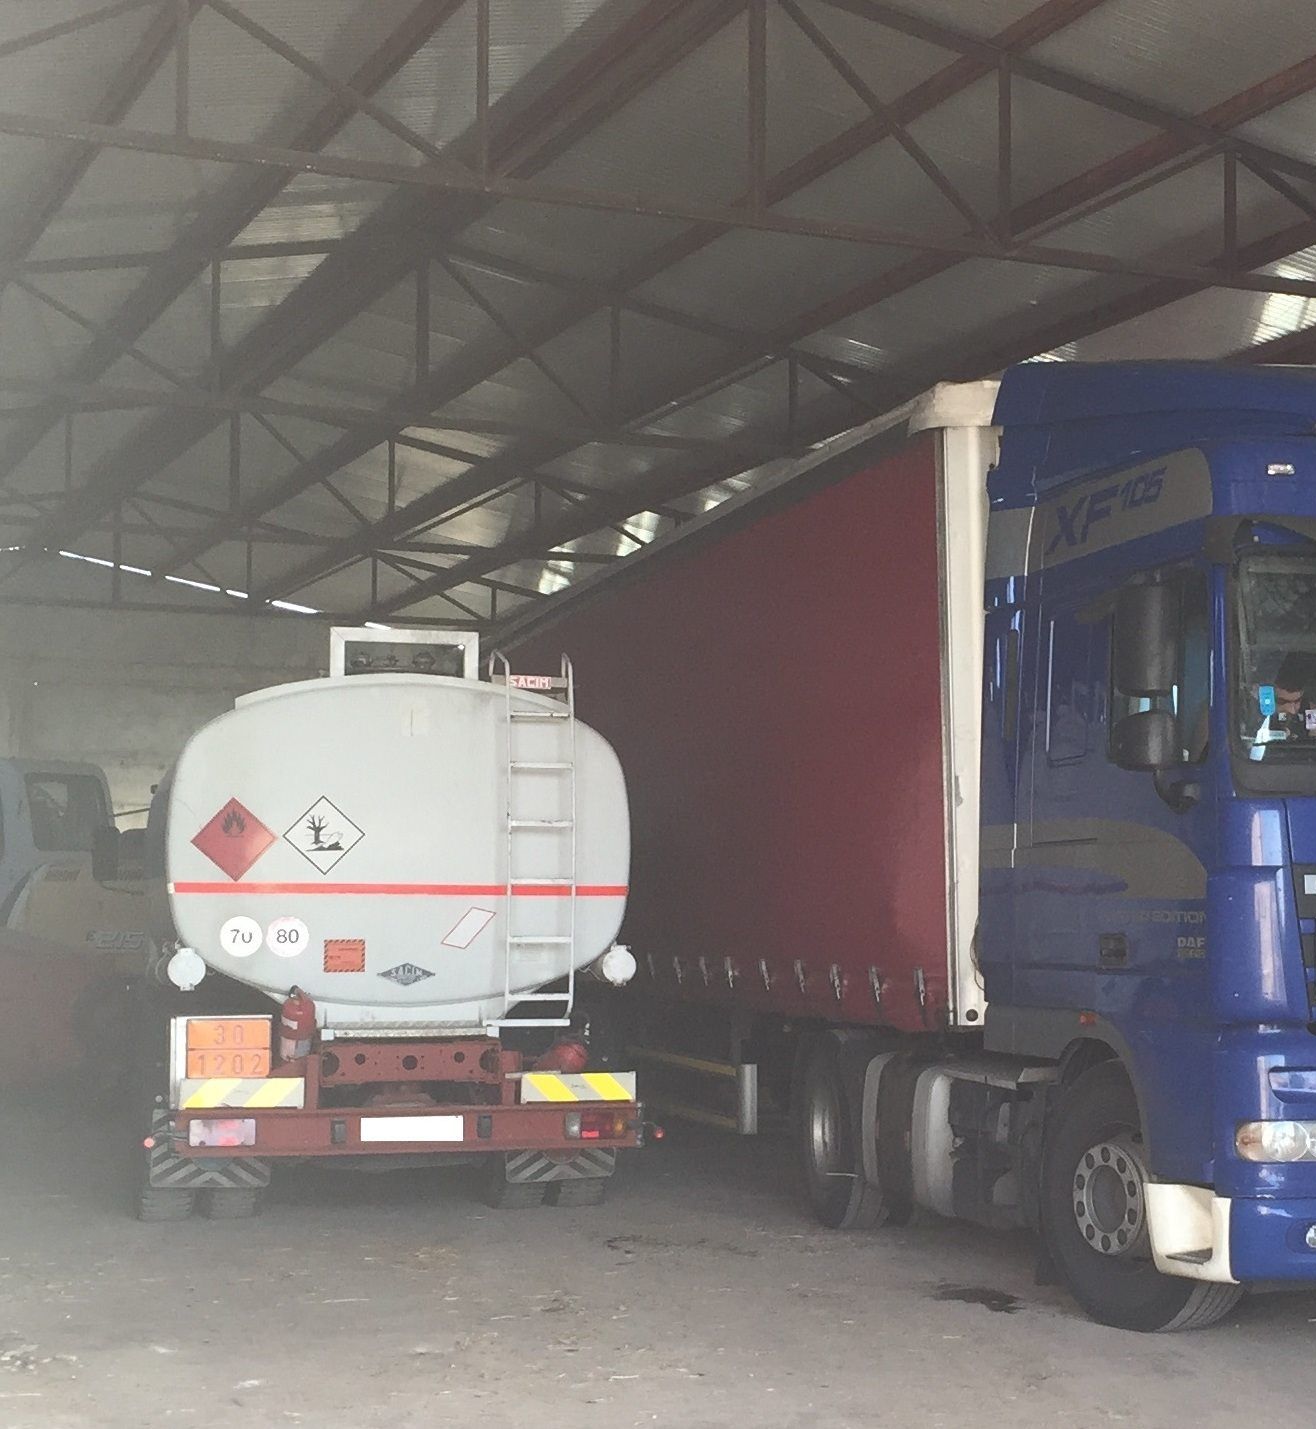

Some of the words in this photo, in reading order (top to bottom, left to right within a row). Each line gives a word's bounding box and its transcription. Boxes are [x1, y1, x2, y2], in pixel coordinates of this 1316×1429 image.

[1044, 484, 1120, 555] XF
[1120, 466, 1168, 510] 105
[509, 675, 550, 689] SACIM
[276, 929, 299, 944] 80
[1177, 936, 1206, 948] DAF
[214, 1024, 244, 1045] 30
[197, 1053, 263, 1075] 1202
